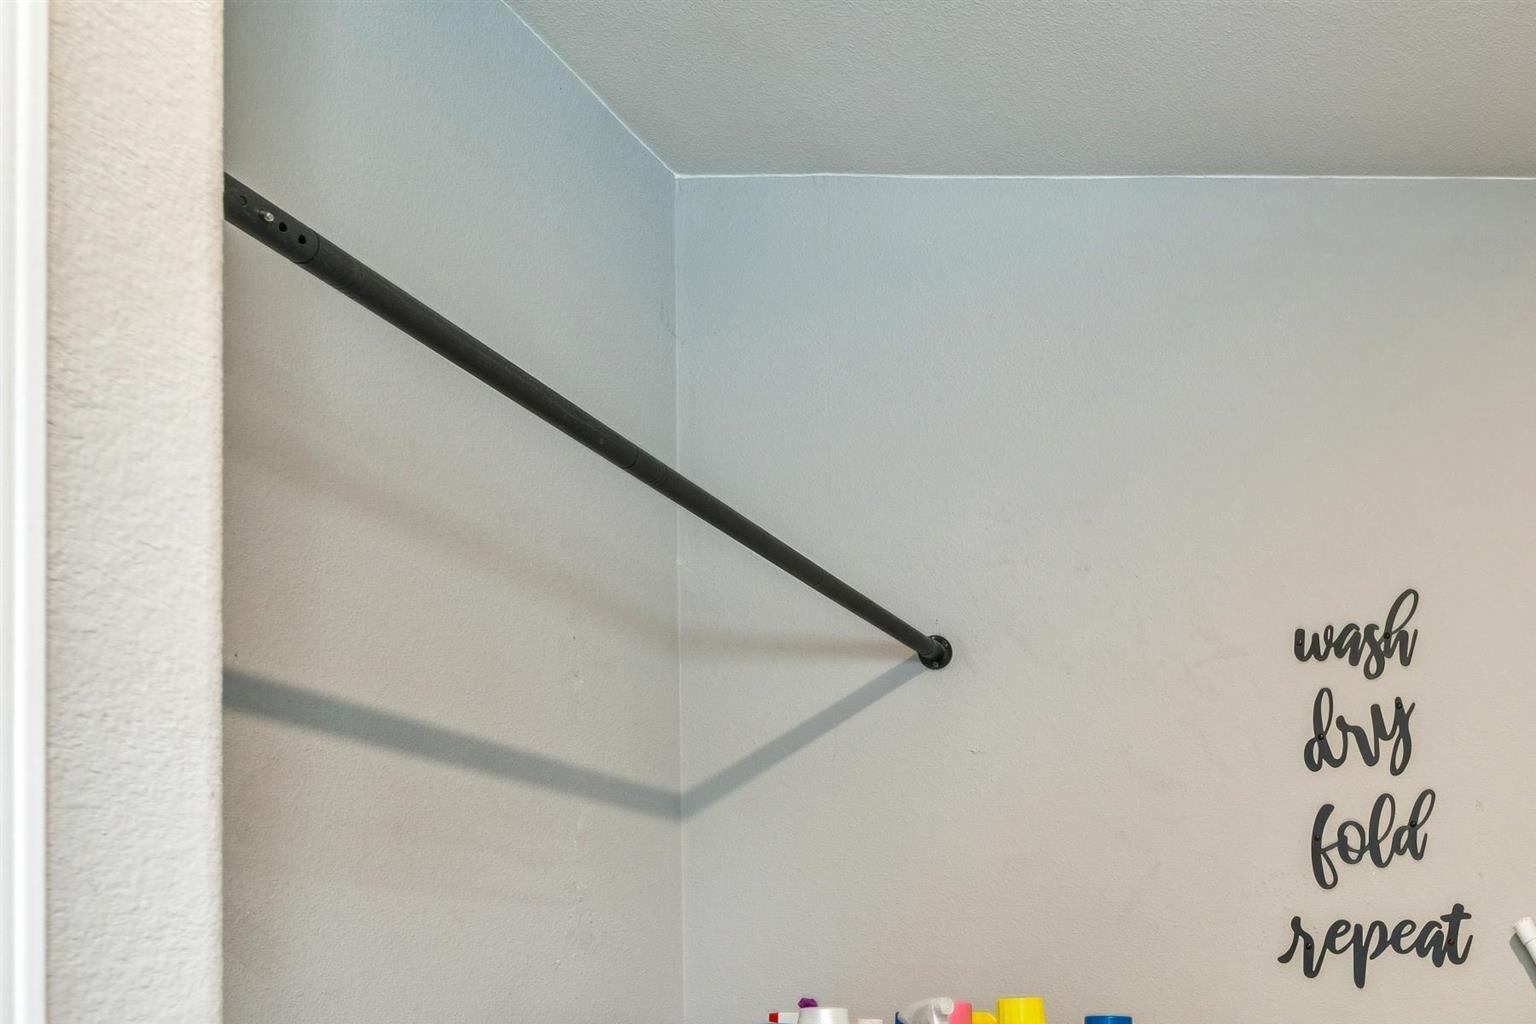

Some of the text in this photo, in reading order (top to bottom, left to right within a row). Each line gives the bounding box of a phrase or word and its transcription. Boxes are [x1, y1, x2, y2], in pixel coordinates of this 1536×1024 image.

[1294, 589, 1419, 679] wash
[1304, 687, 1416, 776] dry
[1311, 790, 1436, 889] fold
[1278, 904, 1474, 988] repeat
